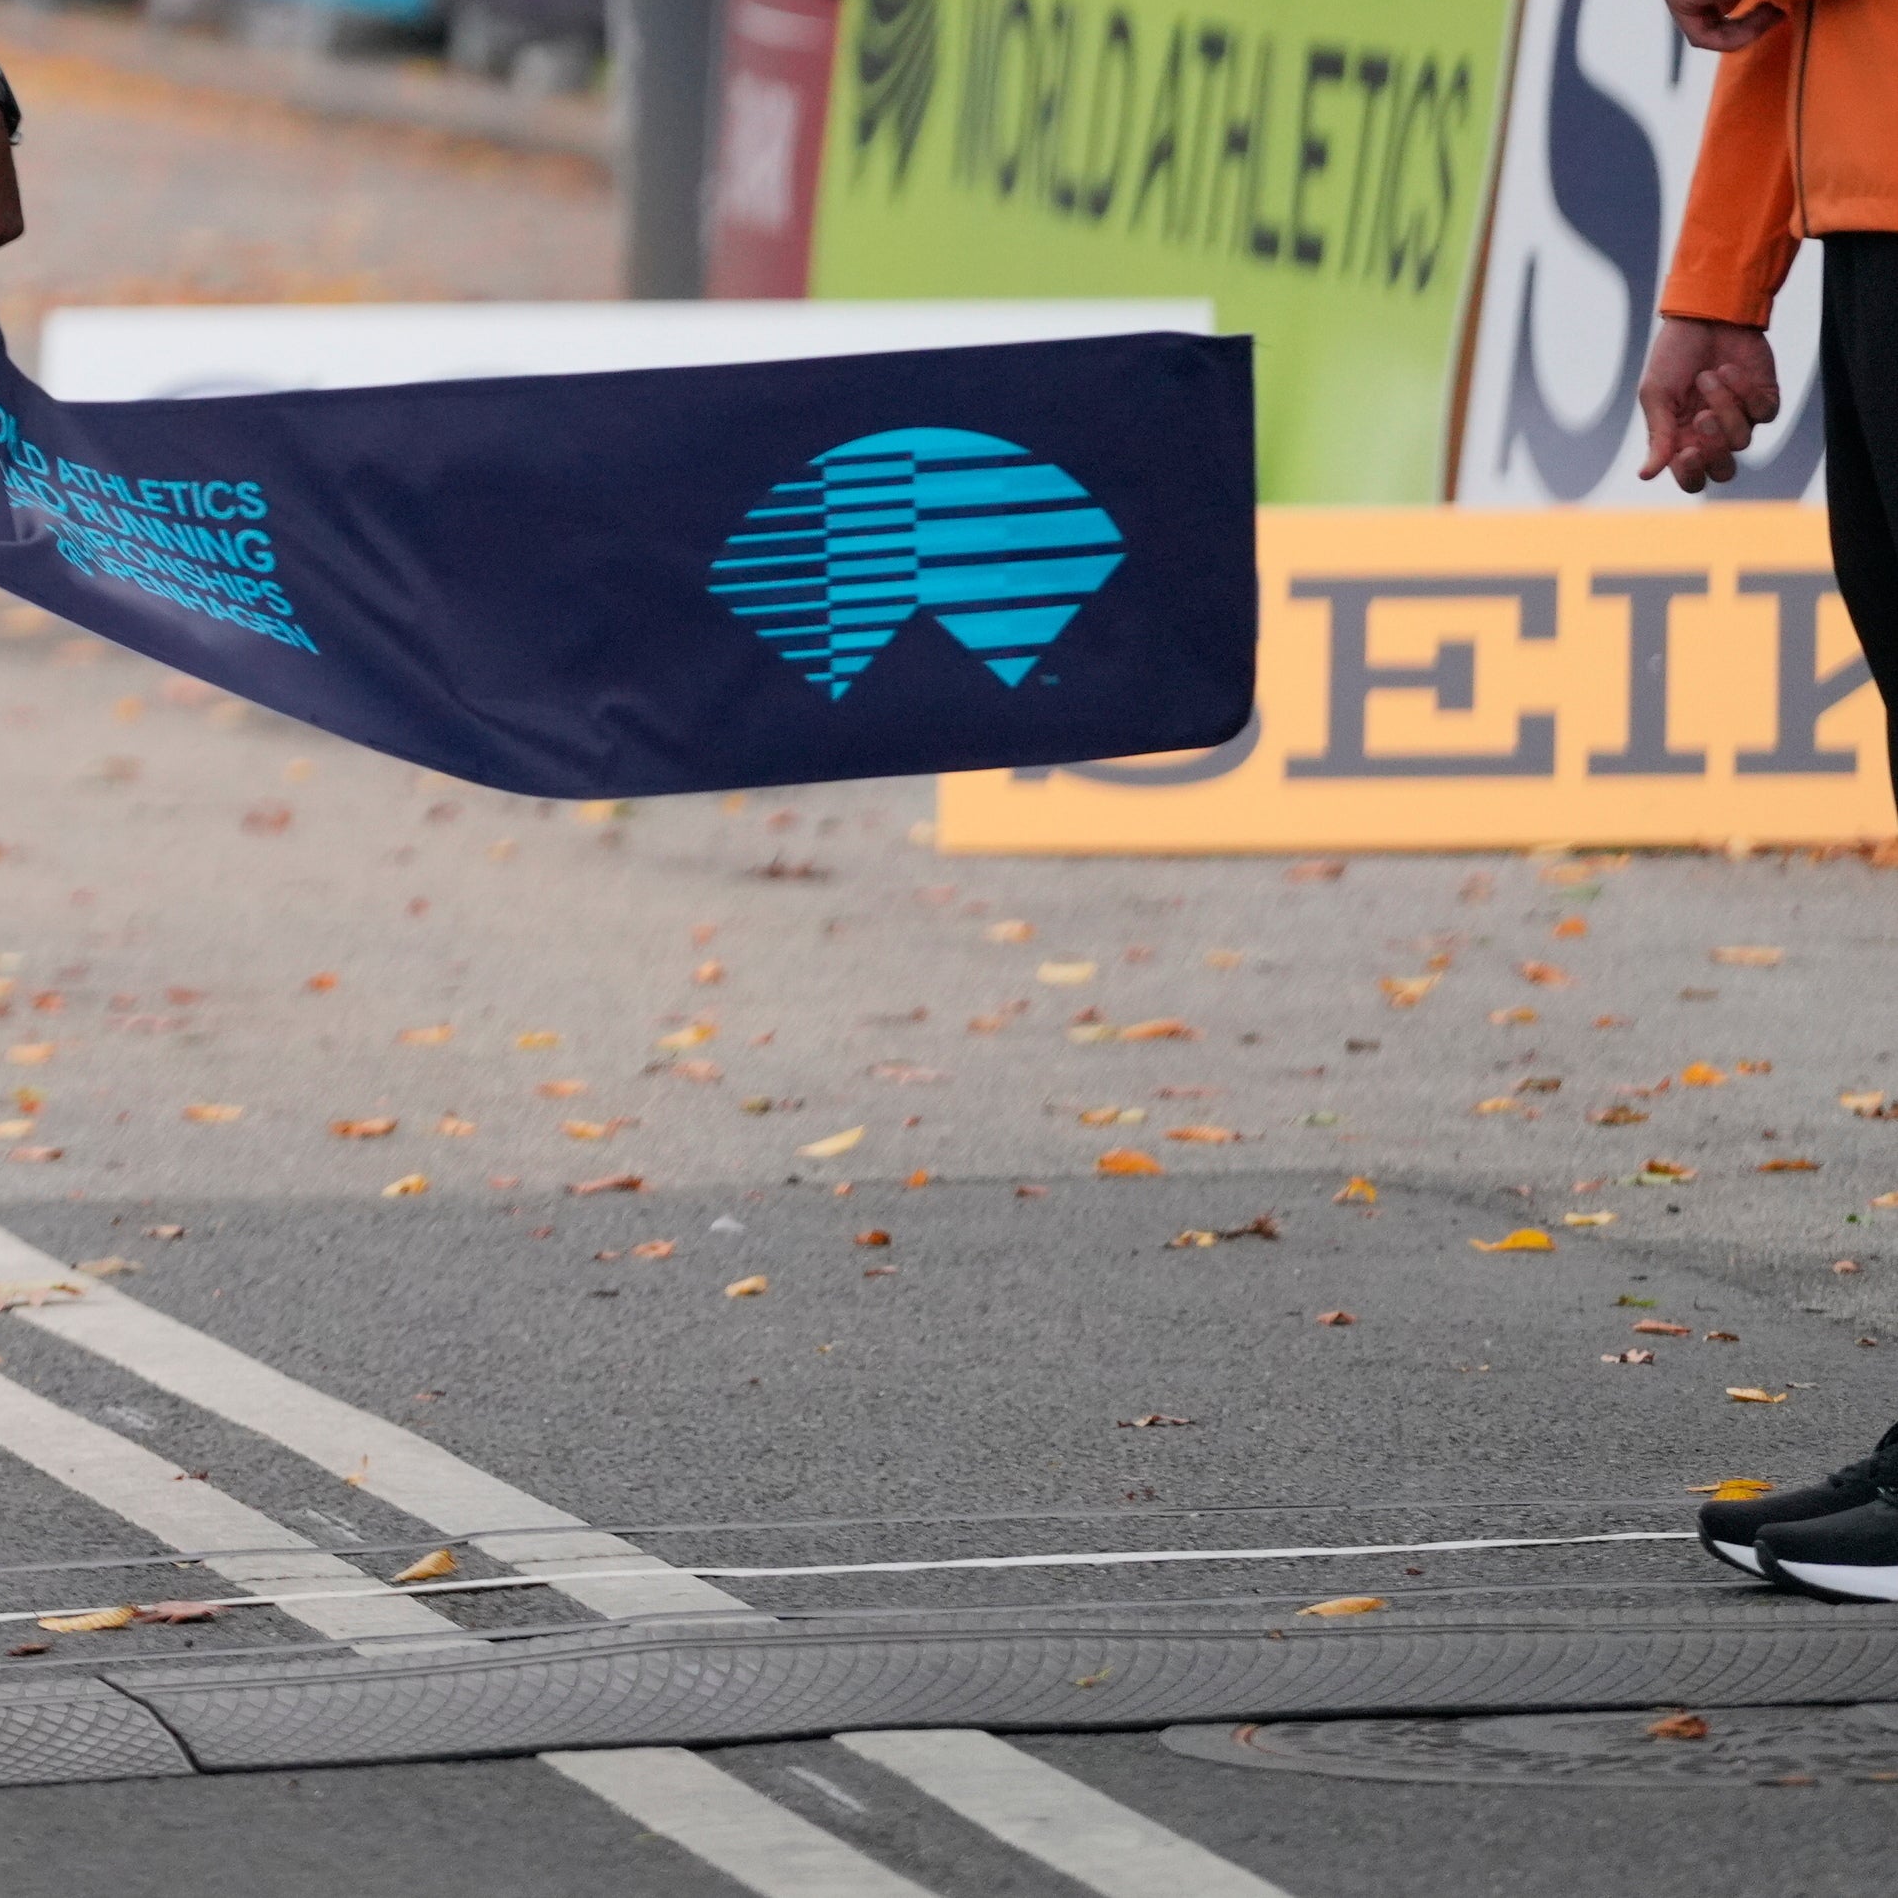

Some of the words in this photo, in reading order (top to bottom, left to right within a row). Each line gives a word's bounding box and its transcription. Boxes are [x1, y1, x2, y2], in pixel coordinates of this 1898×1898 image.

[1125, 14, 1472, 297] ATHLETICS
[56, 457, 268, 520] ATHLETICS
[65, 489, 277, 573] RUNNING
